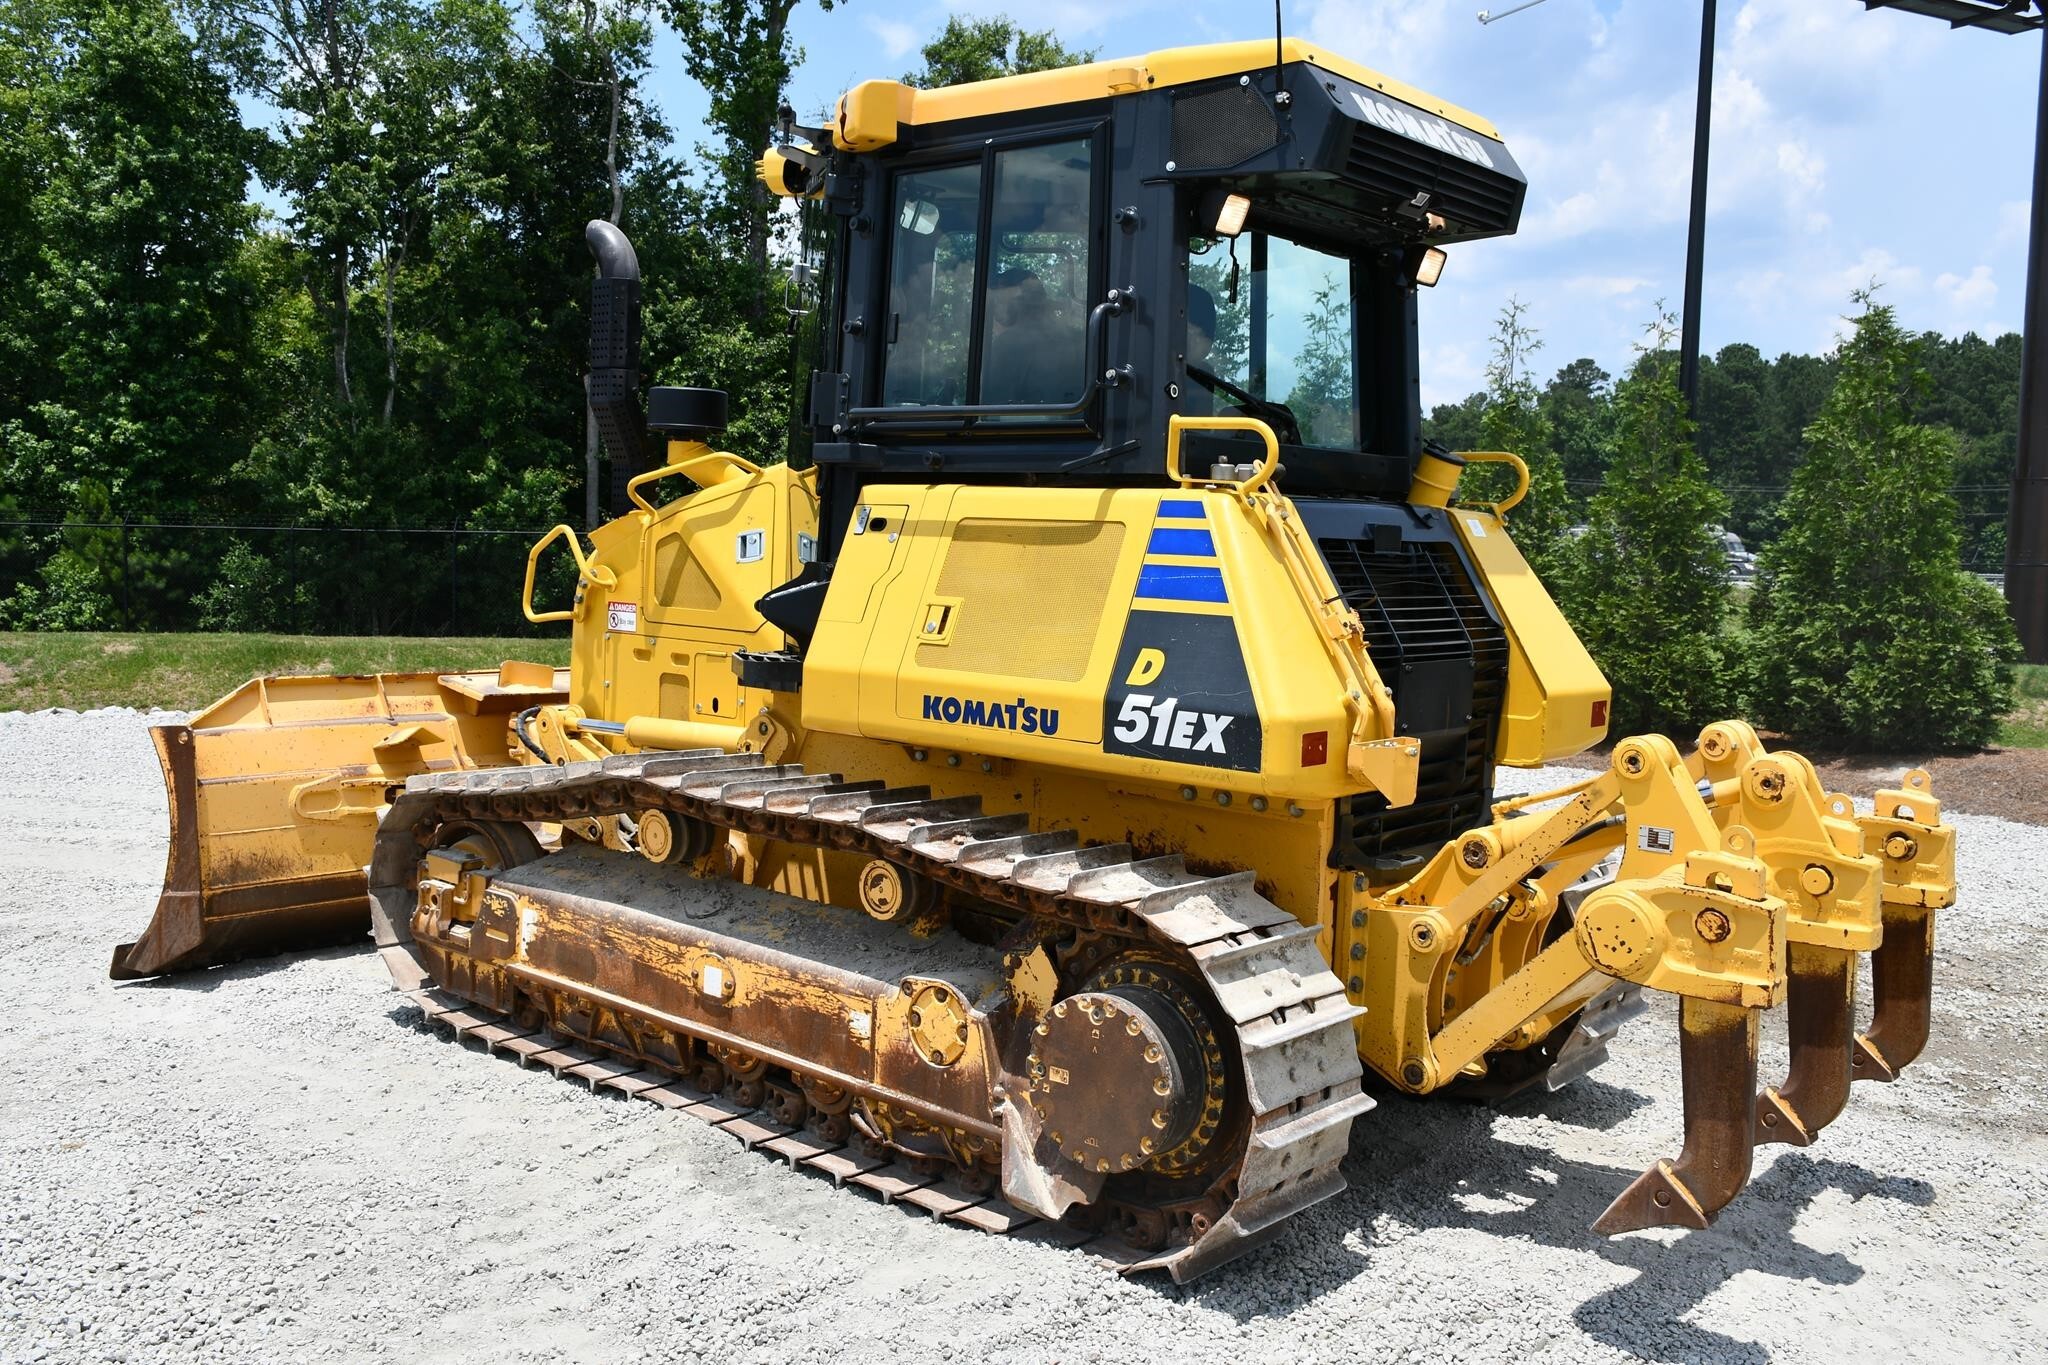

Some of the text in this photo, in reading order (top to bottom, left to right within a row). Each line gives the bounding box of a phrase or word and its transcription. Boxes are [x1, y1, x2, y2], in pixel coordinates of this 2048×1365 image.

[1350, 91, 1493, 168] KOMATSU
[614, 603, 636, 612] DANGER
[1126, 648, 1165, 686] D
[923, 695, 1059, 735] KOMATSU
[1114, 694, 1234, 754] 51EX
